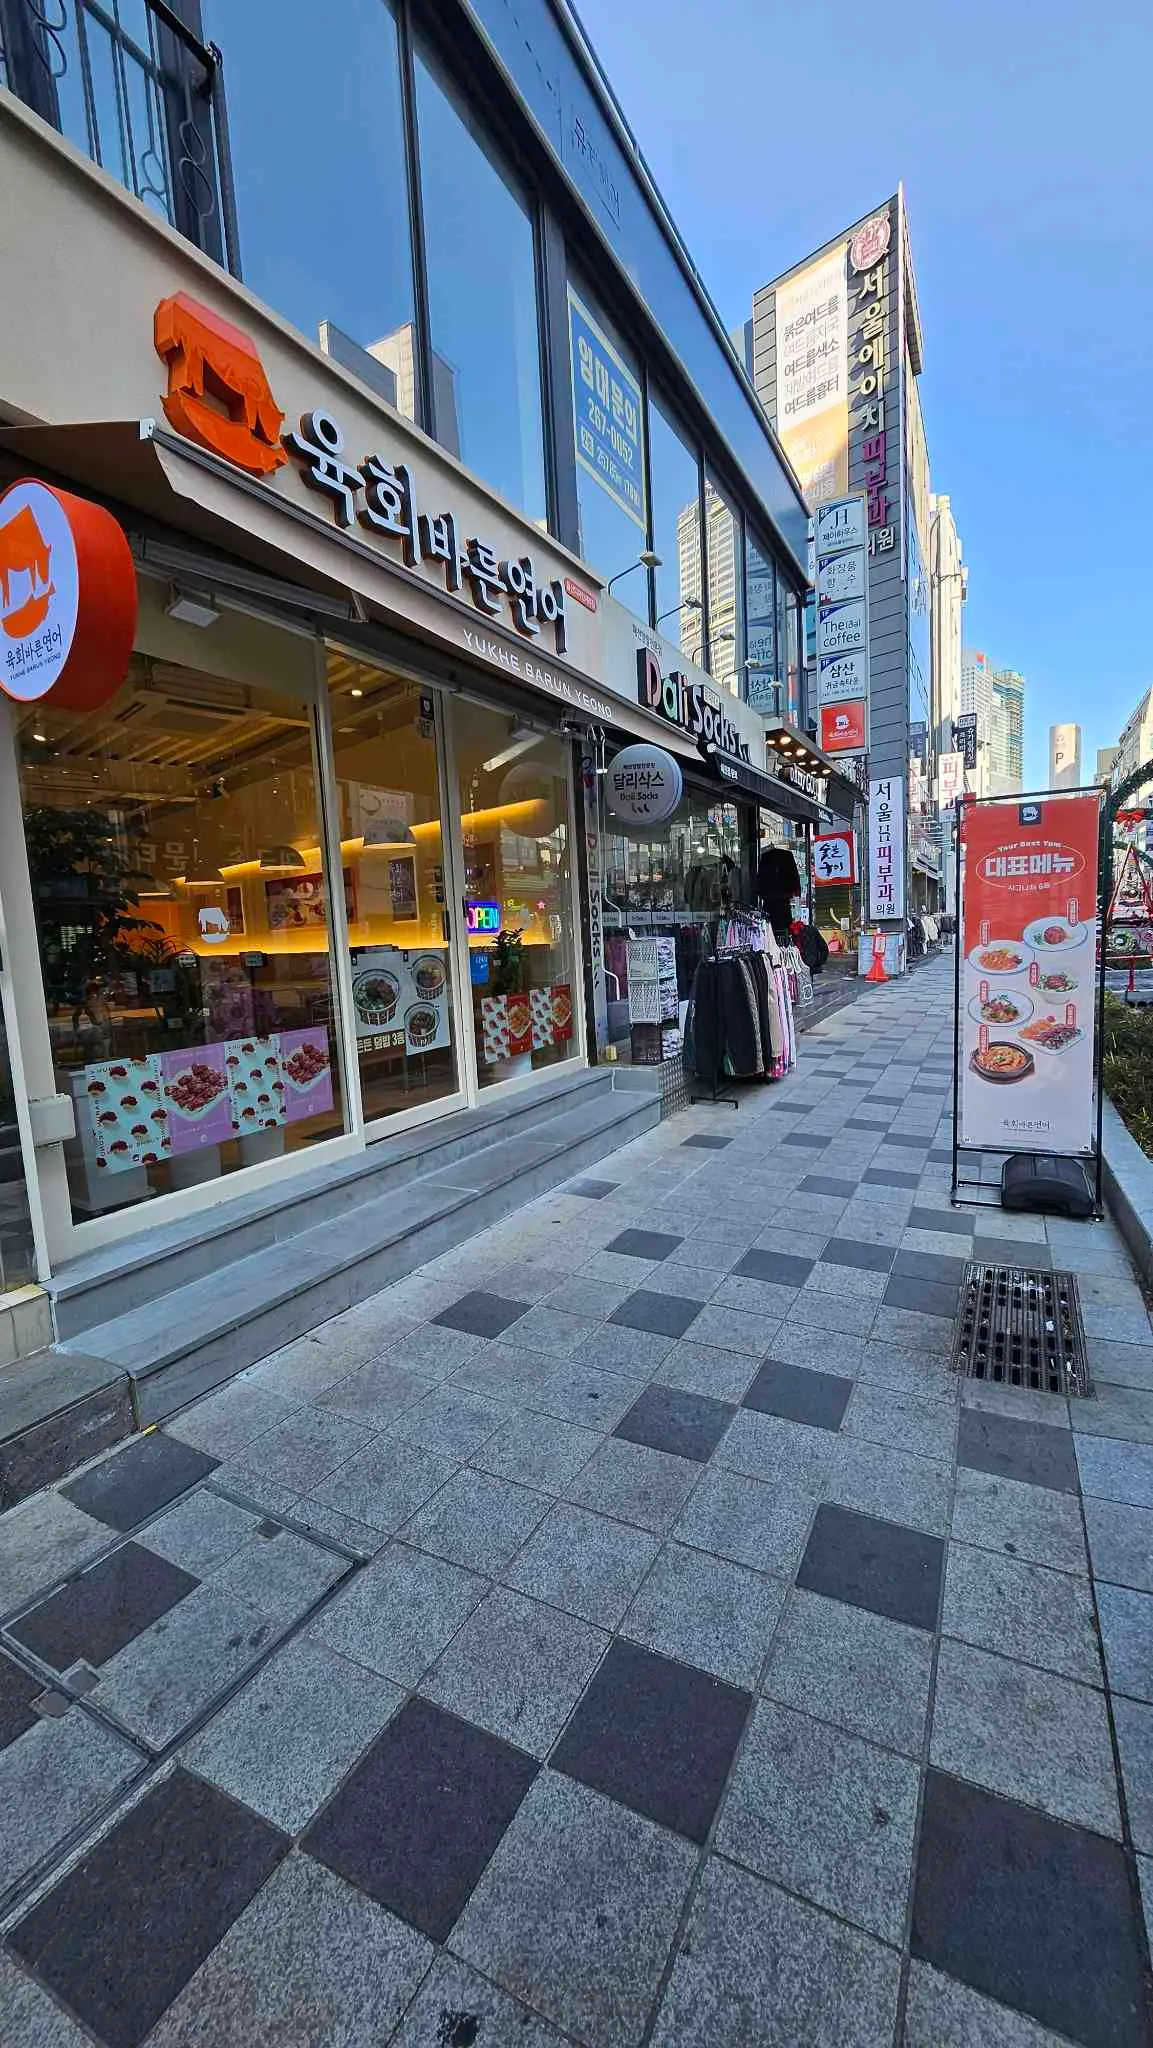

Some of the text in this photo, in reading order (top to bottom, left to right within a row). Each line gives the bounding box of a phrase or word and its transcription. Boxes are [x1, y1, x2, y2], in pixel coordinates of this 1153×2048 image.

[784, 295, 840, 342] 붉은여드름
[784, 338, 840, 377] 여드름색소
[578, 335, 638, 446] 임대문의
[784, 375, 840, 415] 여드름흉터
[588, 397, 634, 471] 267-0052
[284, 409, 568, 656] 육회바른연어
[5, 623, 62, 671] 육회바른연어
[823, 632, 861, 648] coffee
[463, 629, 521, 672] YUKHE
[525, 662, 572, 697] BARUN
[830, 662, 856, 679] 삼산
[638, 647, 737, 754] Dali Socks
[613, 770, 665, 791] 달리삭스
[818, 861, 844, 877] 구이
[985, 853, 1075, 877] 대표메뉴
[466, 907, 499, 929] OPEN
[875, 903, 896, 916] 의원
